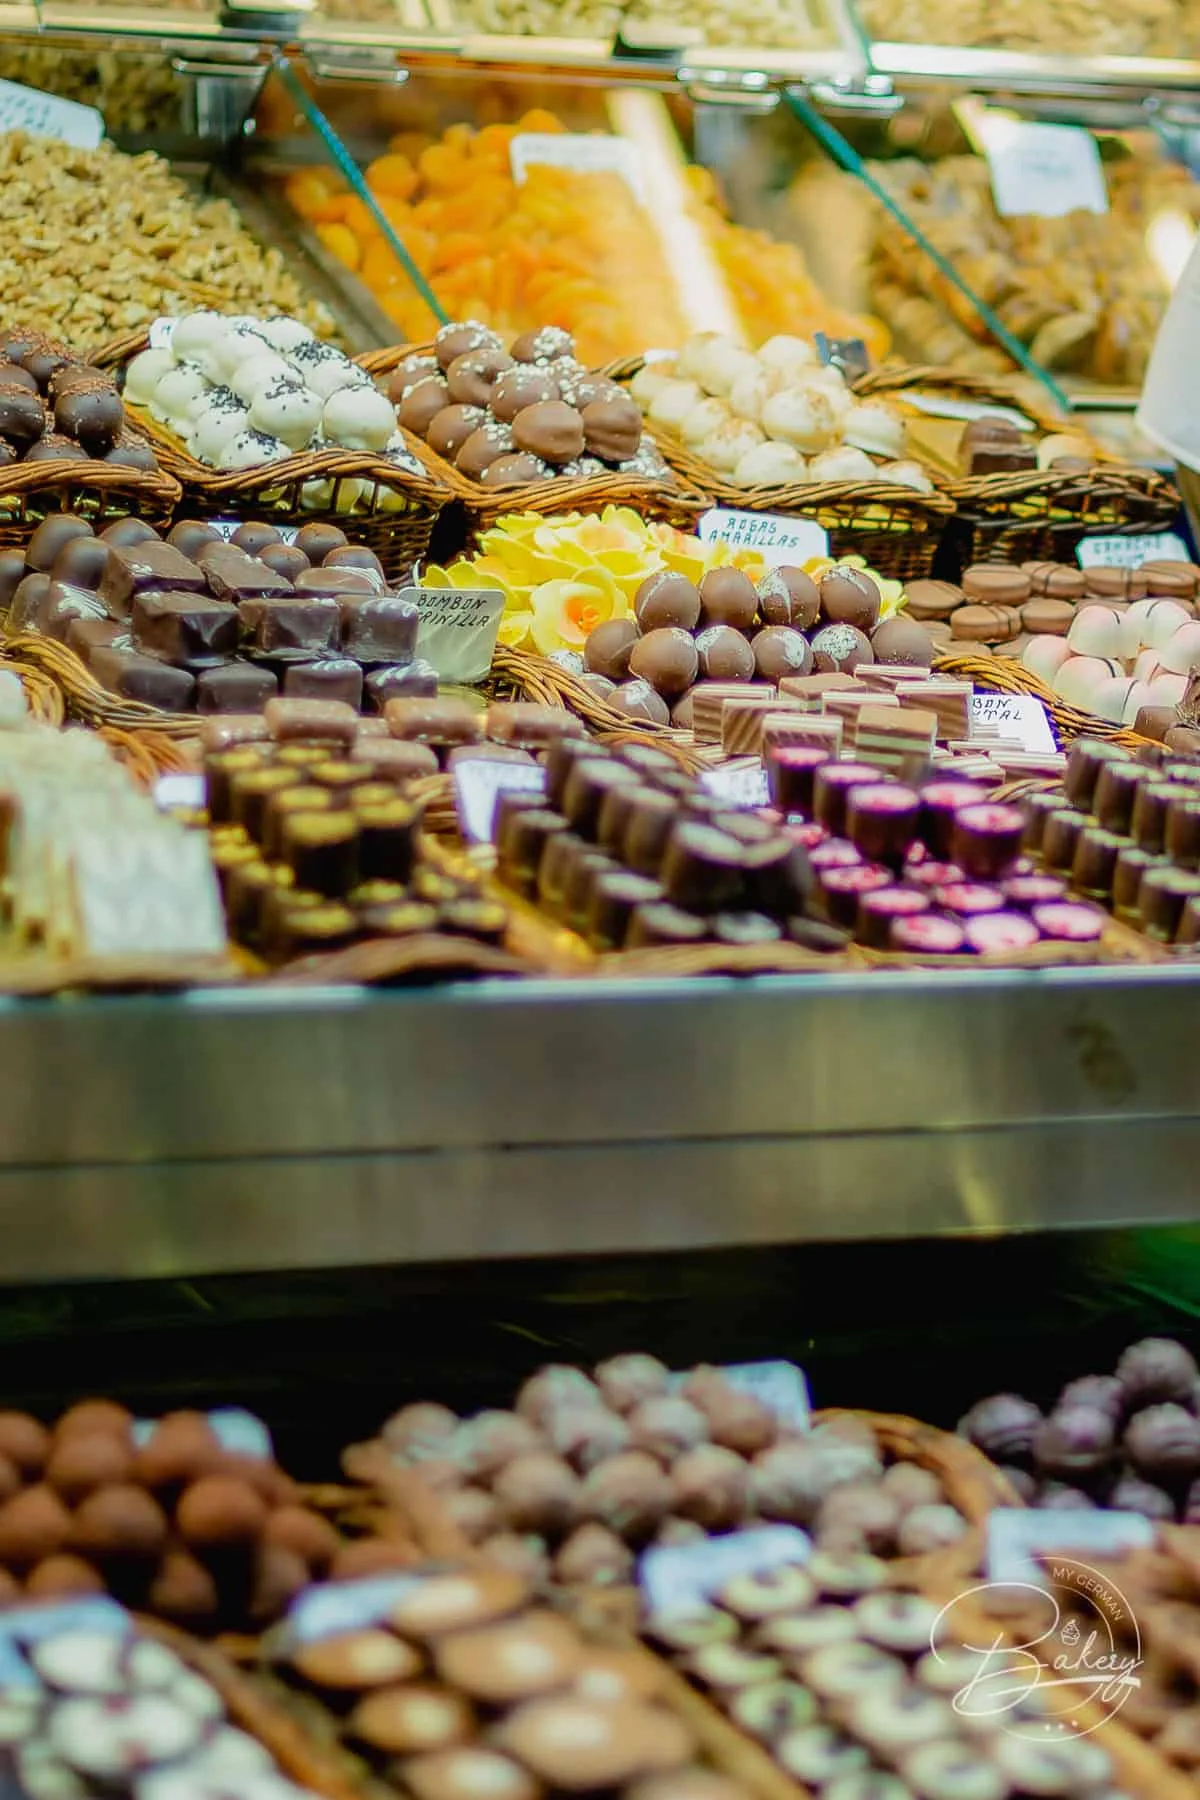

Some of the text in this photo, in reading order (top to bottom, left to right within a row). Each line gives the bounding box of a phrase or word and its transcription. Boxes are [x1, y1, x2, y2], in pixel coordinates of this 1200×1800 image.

[709, 529, 800, 548] AMARILLAS
[417, 593, 488, 610] BOMBON
[972, 697, 1012, 709] BON
